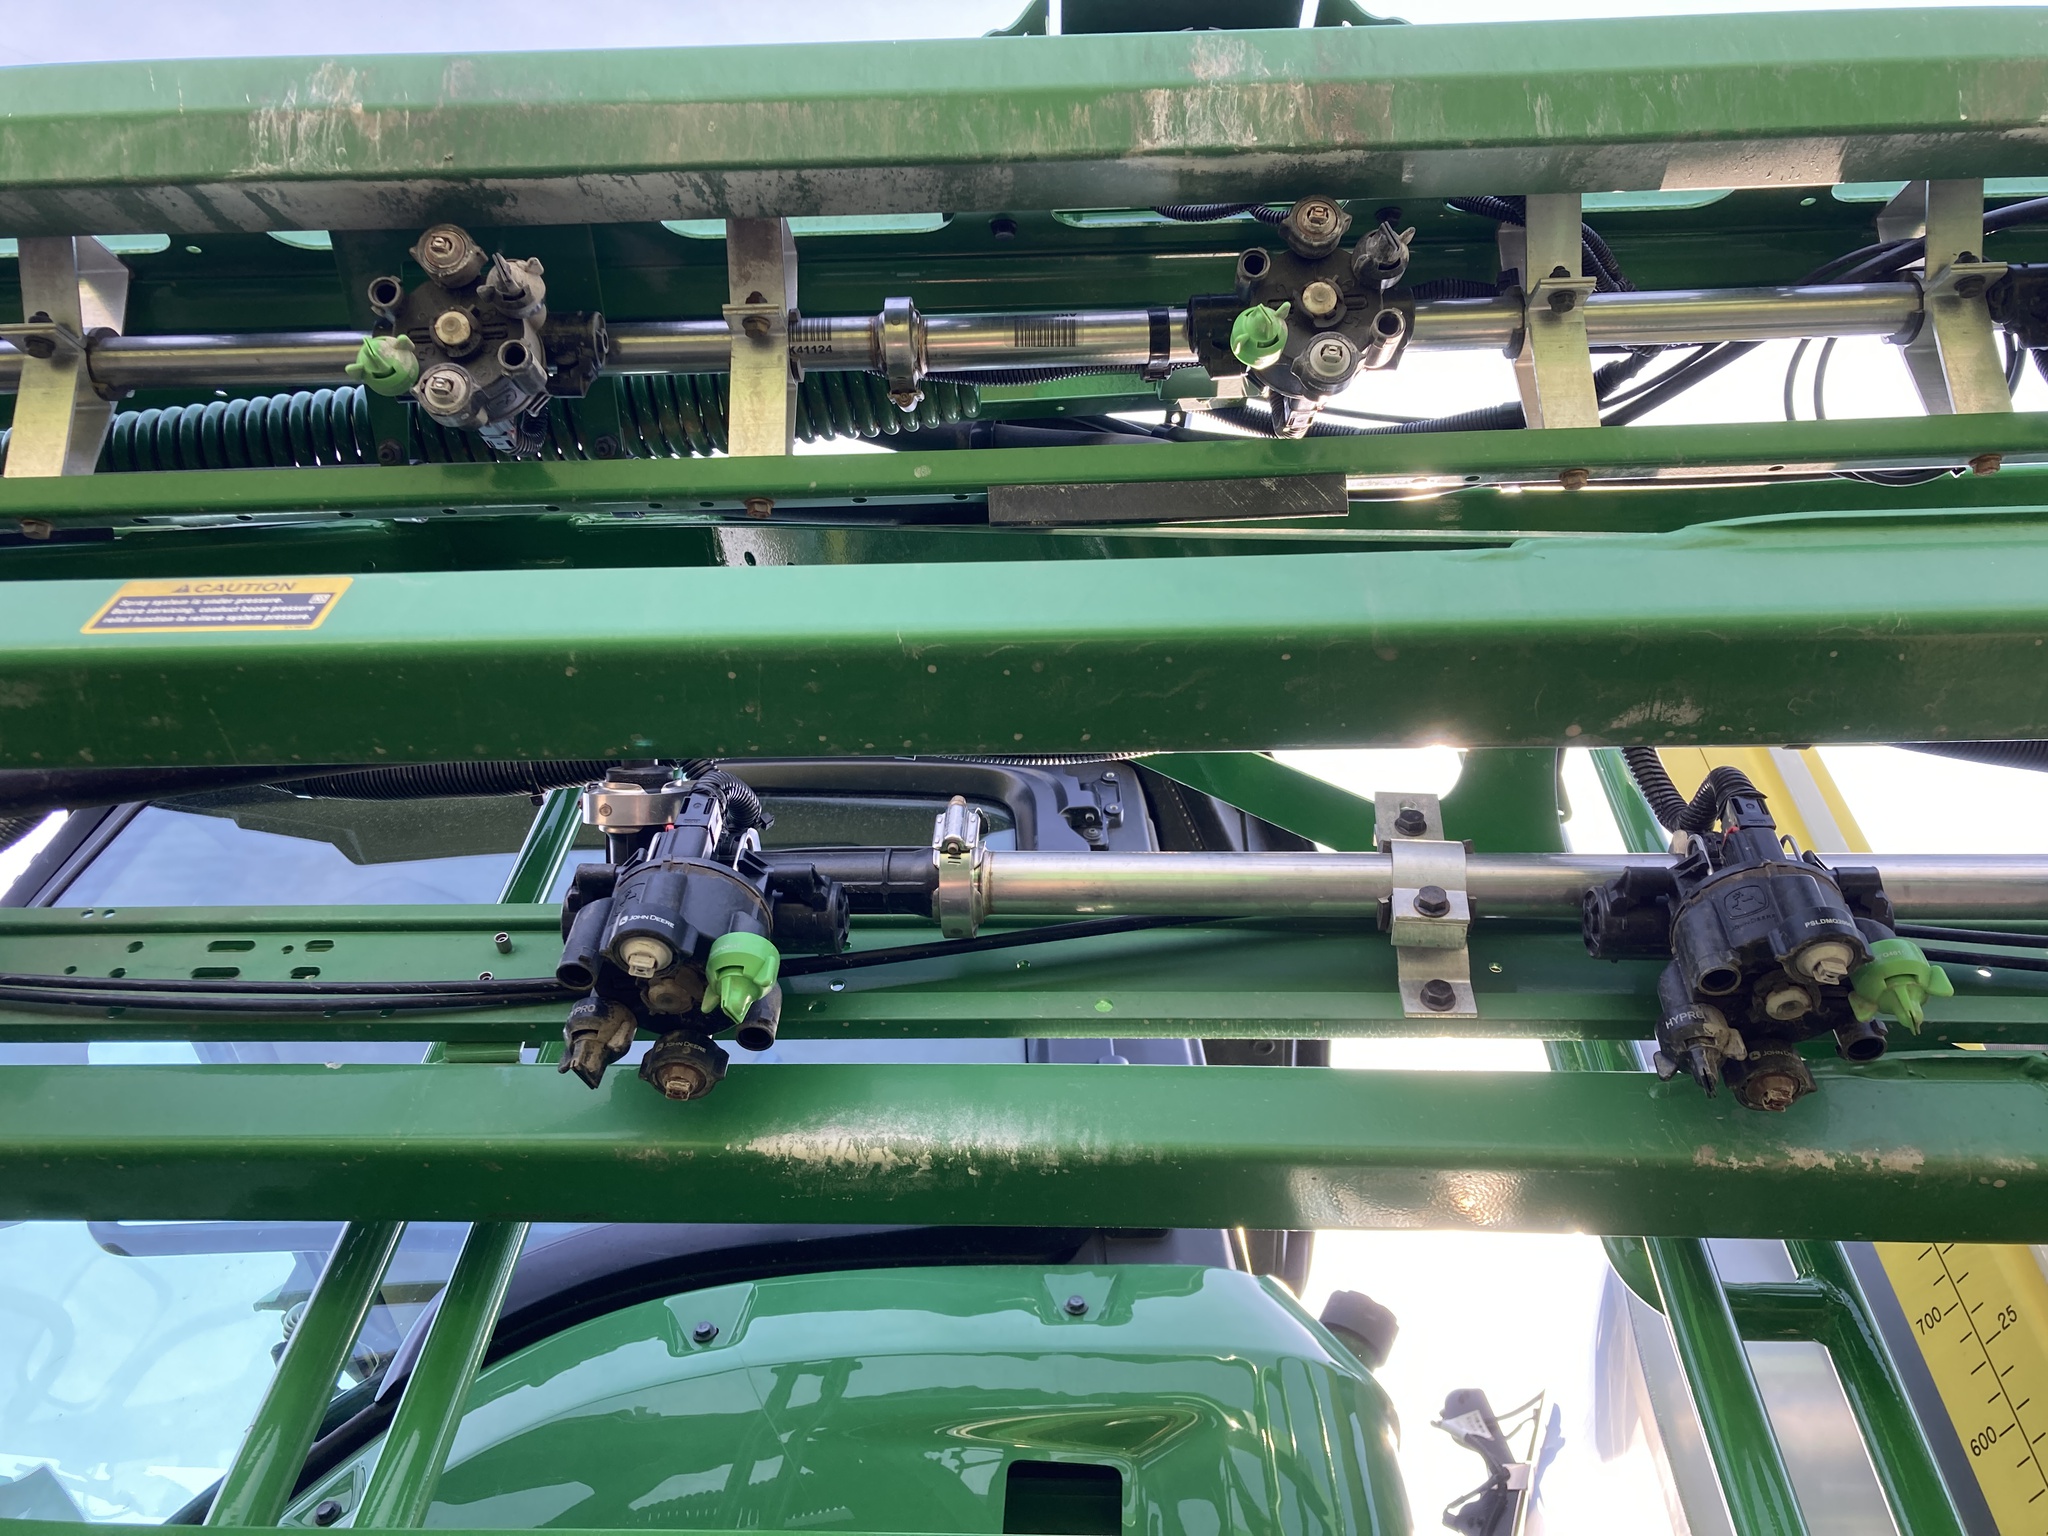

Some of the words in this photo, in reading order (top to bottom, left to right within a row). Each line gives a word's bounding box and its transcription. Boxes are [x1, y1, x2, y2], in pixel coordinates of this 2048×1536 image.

[194, 582, 298, 593] CAUTION
[629, 914, 650, 922] JOHN
[649, 914, 675, 929] DEERE
[1915, 1306, 1942, 1336] 700
[1997, 1304, 2018, 1331] 25
[1970, 1425, 1997, 1458] 600
